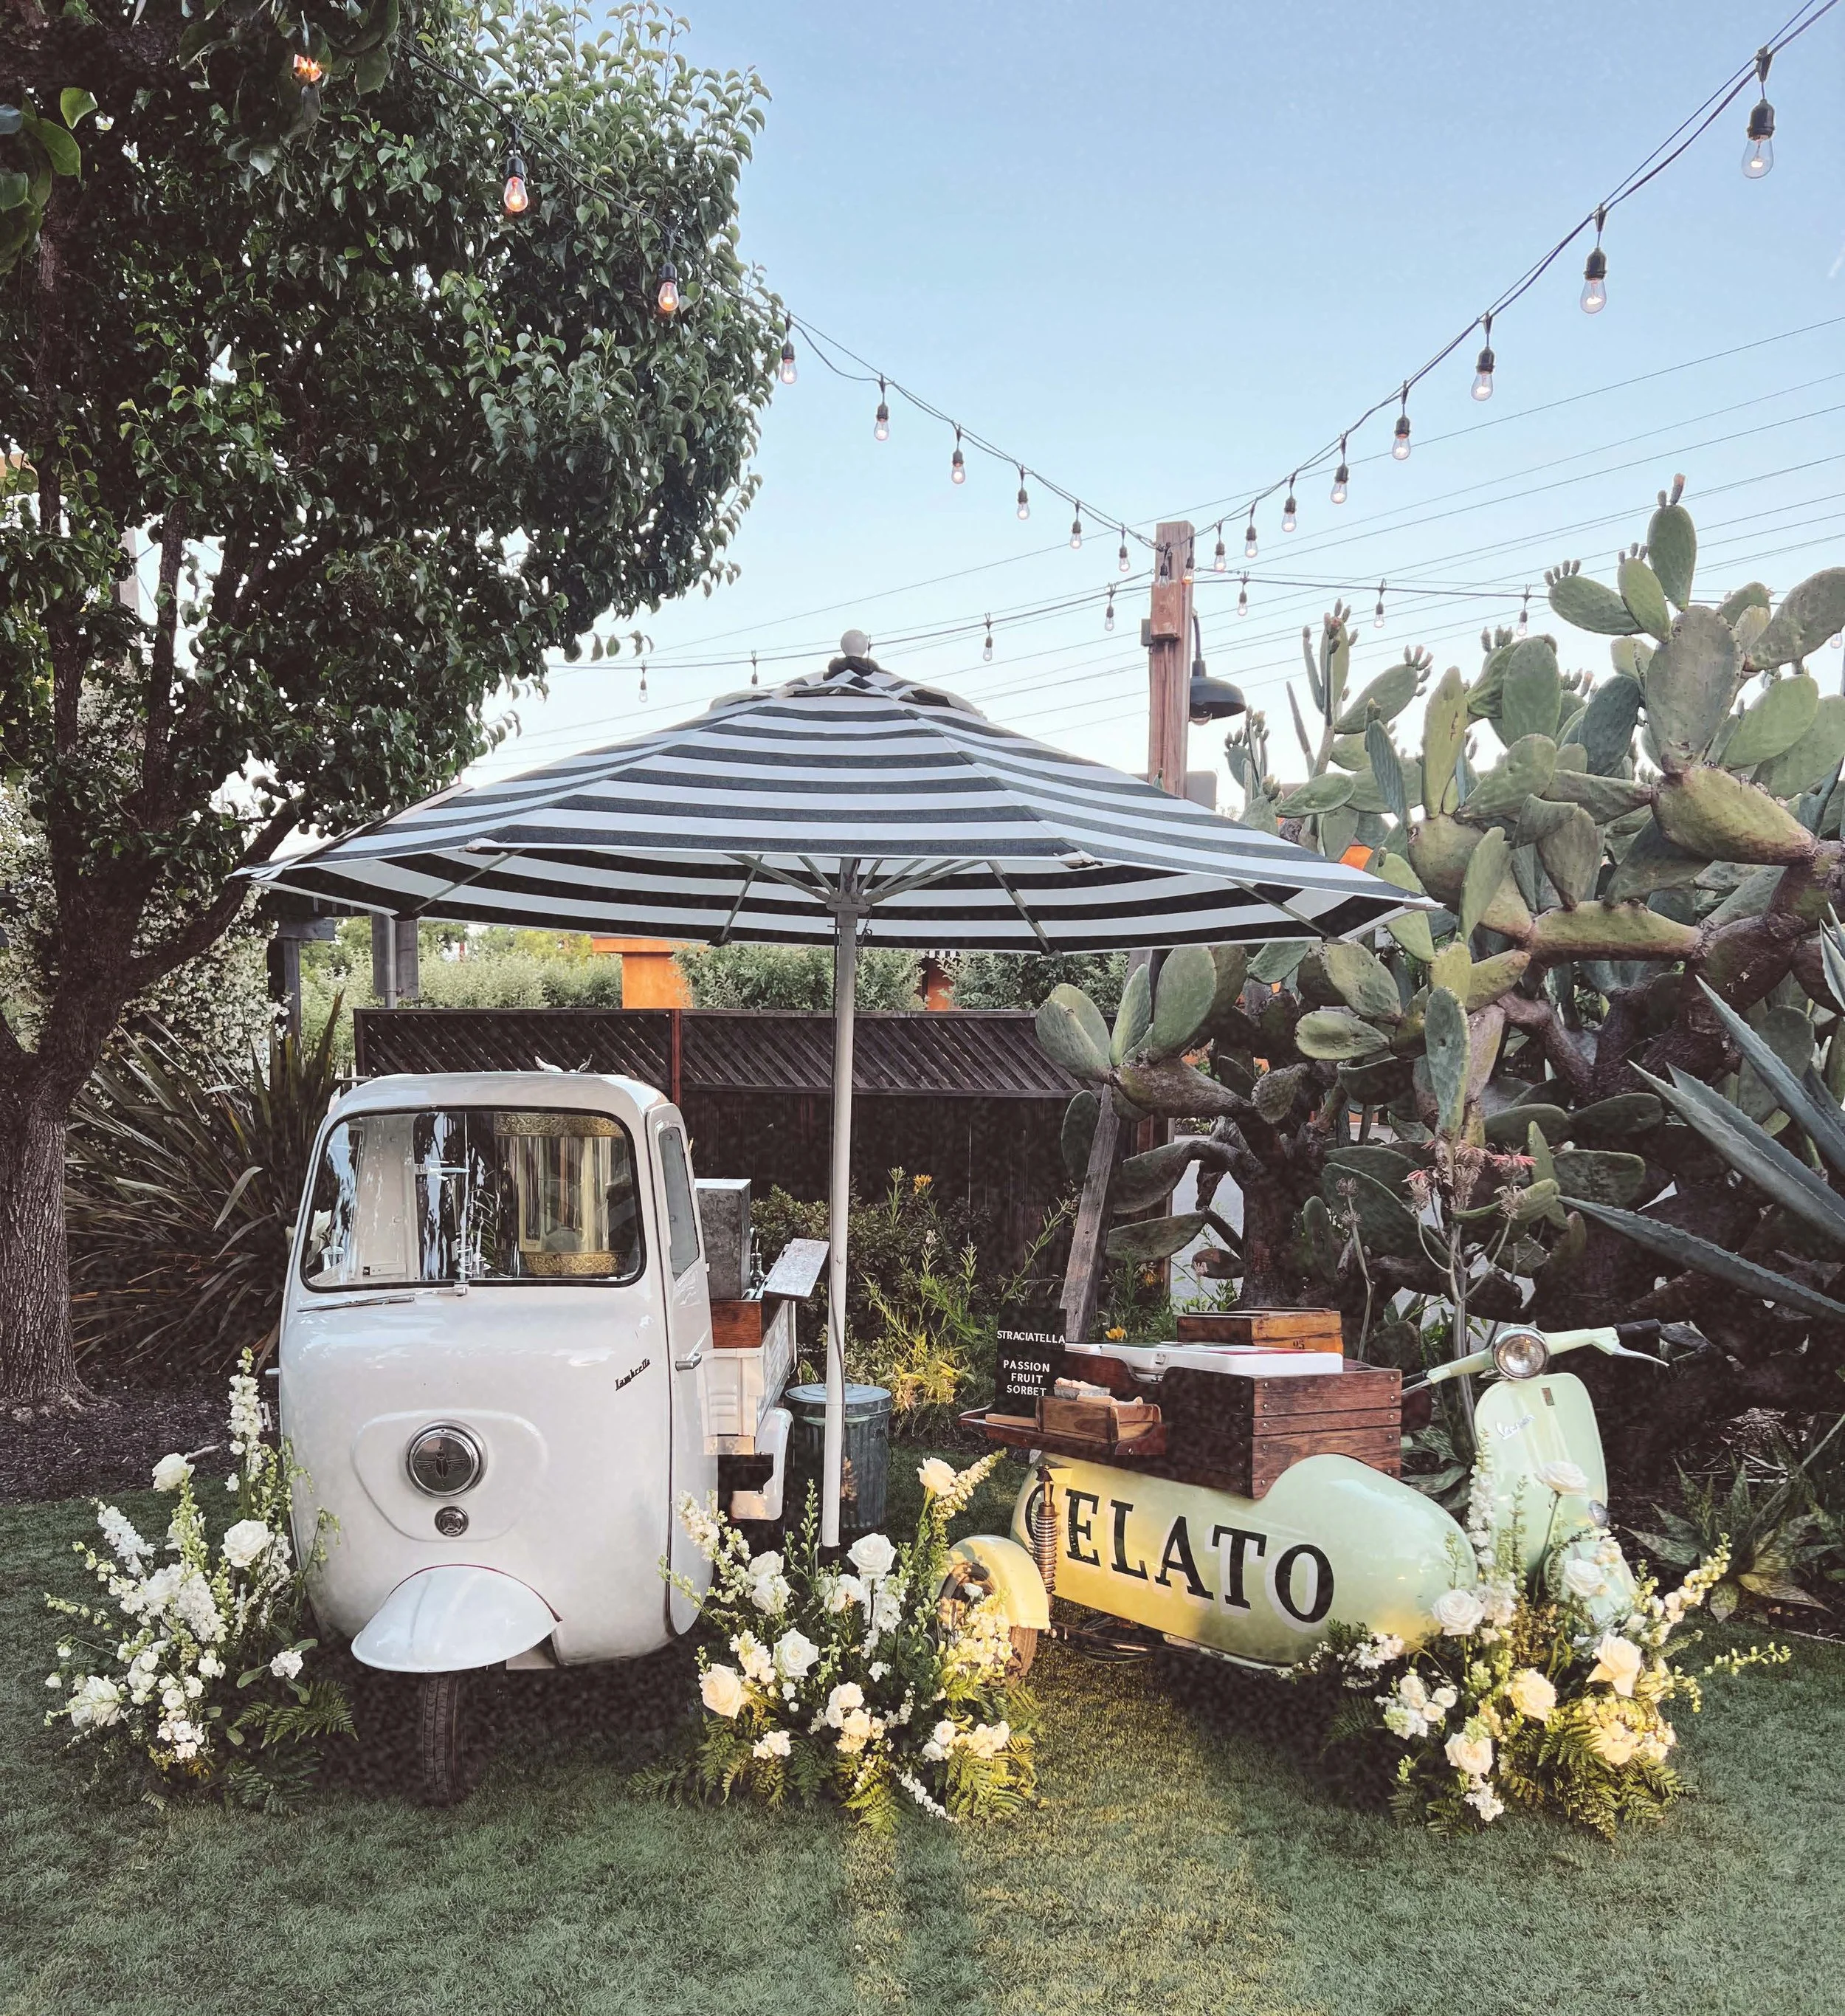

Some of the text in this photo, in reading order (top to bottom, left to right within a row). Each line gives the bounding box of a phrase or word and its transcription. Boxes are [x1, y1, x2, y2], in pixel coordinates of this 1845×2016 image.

[997, 1330, 1066, 1344] STRACIATELLA
[1003, 1360, 1050, 1372] PASSION
[1011, 1373, 1044, 1384] FRUIT
[1007, 1385, 1046, 1397] SORBET
